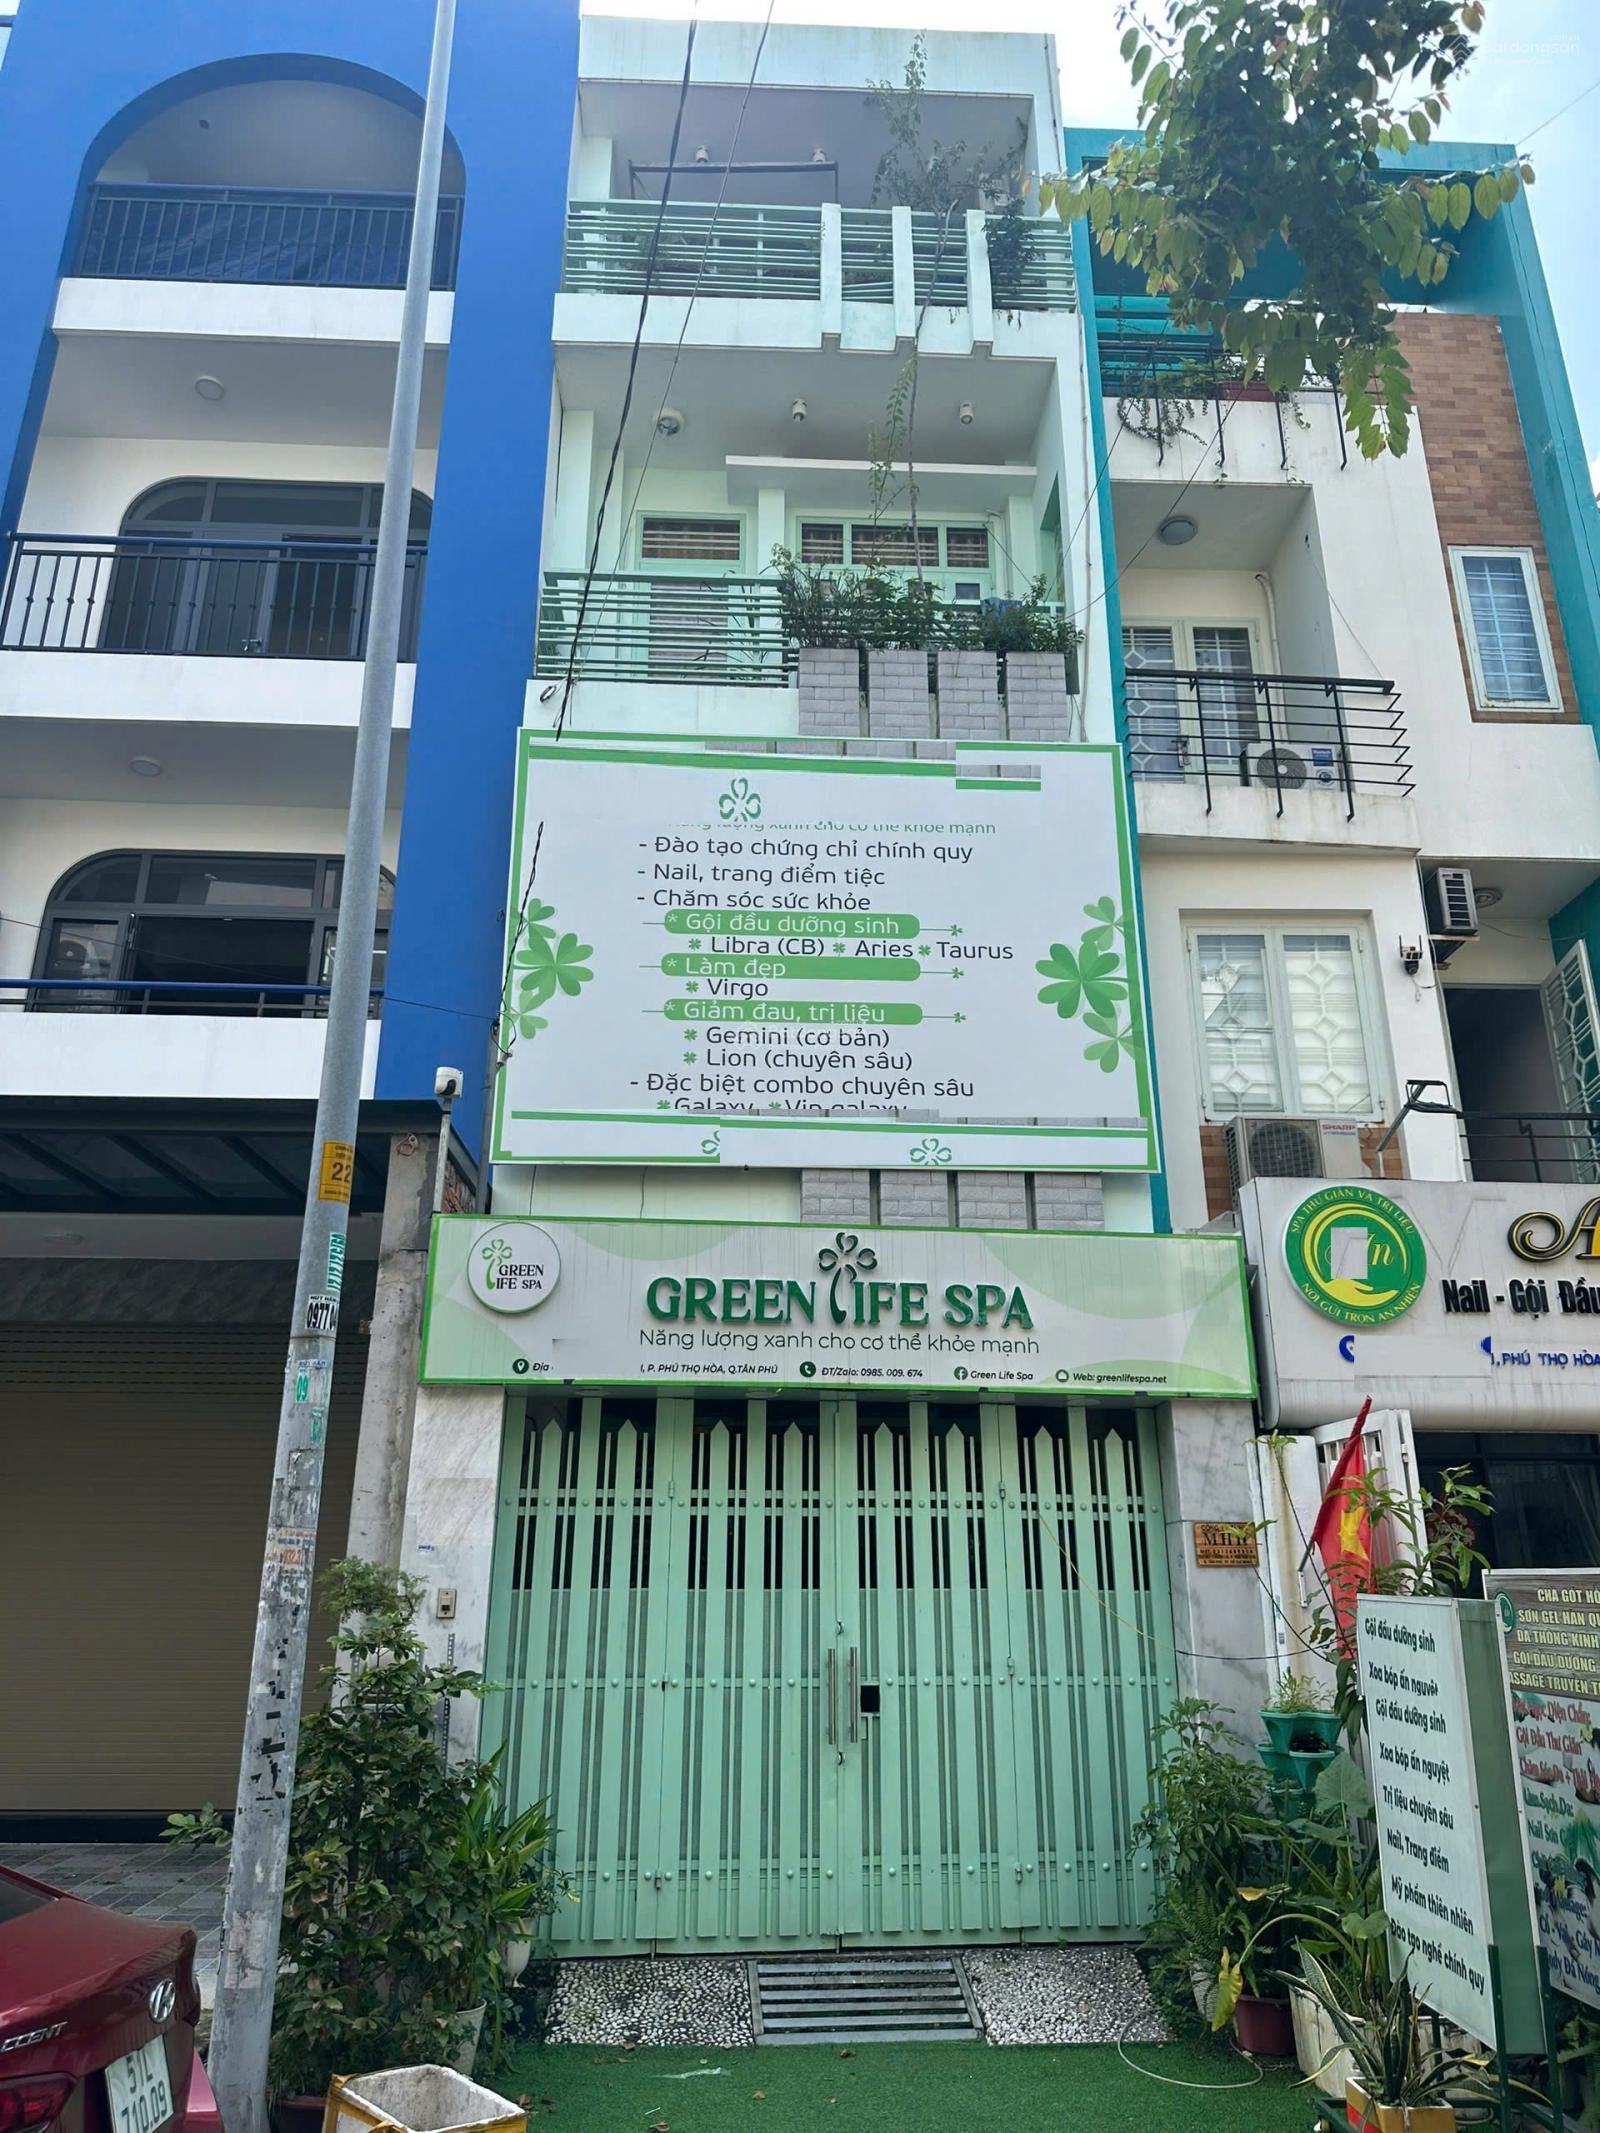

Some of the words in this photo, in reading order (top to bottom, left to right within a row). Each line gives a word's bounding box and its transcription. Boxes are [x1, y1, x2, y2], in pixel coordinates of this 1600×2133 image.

[653, 834, 699, 854] Đào
[707, 838, 743, 858] tạo
[751, 837, 818, 861] chứng
[826, 836, 858, 858] chỉ
[866, 840, 925, 859] chính
[933, 844, 973, 864] quy
[653, 863, 704, 882] Nail,
[711, 865, 772, 886] trang
[780, 862, 836, 885] điểm
[844, 865, 885, 887] tiệc
[652, 887, 719, 907] Chăm
[727, 890, 764, 909] sóc
[771, 890, 810, 910] sức
[817, 891, 872, 912] khỏe
[686, 911, 722, 933] Gội
[730, 911, 770, 931] đầu
[777, 911, 847, 937] dưỡng
[854, 914, 900, 934] sinh
[711, 935, 770, 954] Libra
[777, 937, 826, 957] (CB)
[855, 938, 914, 958] Aries
[936, 941, 1014, 960] Taurus
[685, 954, 736, 977] Làm
[743, 955, 787, 980] đẹp
[707, 978, 769, 1000] Virgo
[683, 999, 744, 1020] Giảm
[752, 1002, 802, 1023] đau,
[809, 1003, 836, 1025] trị
[844, 1002, 886, 1025] liệu
[706, 1025, 789, 1046] Gemini
[796, 1027, 831, 1048] (cơ
[838, 1026, 891, 1049] bản)
[706, 1049, 757, 1068] Lion
[764, 1049, 856, 1073] (chuyên
[863, 1049, 914, 1071] sâu)
[646, 1072, 693, 1096] Đặc
[700, 1073, 746, 1096] biệt
[753, 1075, 834, 1095] combo
[842, 1075, 926, 1101] chuyên
[933, 1077, 975, 1098] sâu
[1290, 1215, 1305, 1233] SPA
[498, 1264, 545, 1277] GREEN
[521, 1279, 543, 1290] SPA
[646, 1276, 816, 1326] GREEN
[943, 1283, 1035, 1330] SPA
[1441, 1279, 1491, 1314] Nail
[1507, 1278, 1551, 1321] Gội
[640, 1328, 695, 1350] Năng
[702, 1329, 758, 1351] lượng
[764, 1331, 813, 1349] xanh
[818, 1331, 856, 1350] cho
[860, 1334, 884, 1351] cơ
[889, 1332, 922, 1351] thể
[928, 1333, 976, 1352] khỏe
[981, 1336, 1040, 1358] mạnh
[532, 1362, 551, 1373] Địa
[647, 1364, 657, 1374] P.
[658, 1361, 680, 1374] PHÚ
[681, 1364, 702, 1375] THỌ
[757, 1362, 780, 1375] PHÚ
[860, 1367, 885, 1377] 0985.
[886, 1367, 906, 1378] 009.
[907, 1368, 924, 1378] 674
[1537, 1352, 1569, 1370] THỌ
[970, 1370, 998, 1381] Green
[998, 1371, 1016, 1381] Life
[1016, 1371, 1035, 1383] Spa
[1073, 1372, 1096, 1383] Web:
[1541, 1609, 1561, 1625] GEL
[1364, 1617, 1377, 1641] Gội
[1418, 1628, 1436, 1653] sinh
[1570, 1632, 1600, 1650] KINH
[1368, 1660, 1383, 1682] Xoa
[1384, 1664, 1399, 1691] bóp
[1400, 1667, 1411, 1691] ấn
[1375, 1697, 1388, 1723] Gội
[1429, 1709, 1447, 1735] sinh
[1379, 1741, 1394, 1763] Xoa
[1394, 1745, 1410, 1772] bóp
[1410, 1748, 1421, 1773] ấn
[1382, 1784, 1394, 1811] Trị
[1393, 1786, 1408, 1814] liệu
[1409, 1795, 1438, 1824] chuyên
[1439, 1806, 1454, 1830] sâu
[1387, 1827, 1405, 1855] Nail,
[1404, 1835, 1428, 1868] Trang
[1427, 1893, 1450, 1922] thiên
[1450, 1906, 1474, 1936] nhiên
[1390, 1917, 1407, 1943] Đào
[1443, 1949, 1468, 1981] chính
[1468, 1967, 1485, 1997] quy
